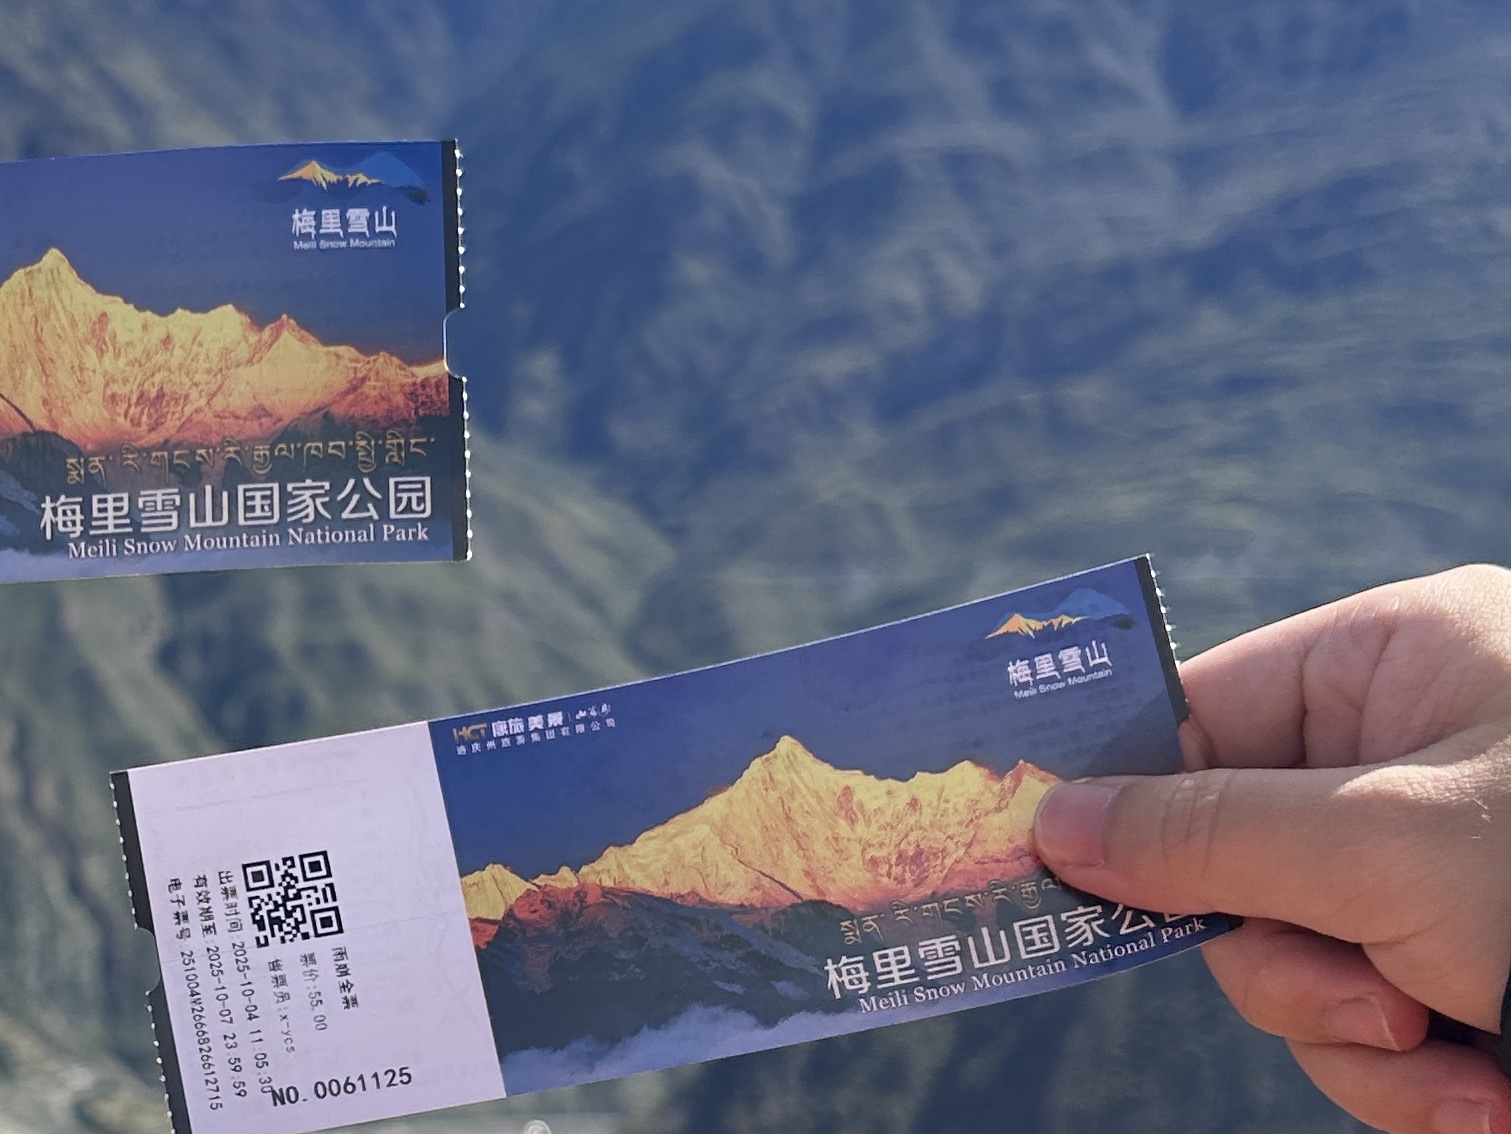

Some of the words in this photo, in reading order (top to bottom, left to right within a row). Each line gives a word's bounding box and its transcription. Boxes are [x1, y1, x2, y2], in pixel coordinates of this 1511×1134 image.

[291, 205, 398, 240] 梅里雪山
[294, 240, 316, 250] Meili
[319, 239, 347, 249] Snow
[349, 238, 395, 248] Mountain
[40, 475, 432, 541] 梅里雪山国家公园
[68, 540, 118, 560] Meili
[123, 537, 179, 556] Snow
[183, 530, 281, 552] Mountain
[288, 524, 376, 545] National
[382, 522, 430, 542] Park
[1007, 640, 1113, 687] 梅里雪山
[1014, 687, 1037, 699] Meili
[1039, 681, 1066, 694] Snow
[1068, 668, 1112, 686] Mountain
[824, 903, 1182, 1000] 梅里雪山国家公
[859, 987, 910, 1014] Meili
[914, 979, 967, 1003] Snow
[971, 959, 1068, 991] Mountain
[1072, 933, 1157, 969] National
[1161, 917, 1207, 944] Park
